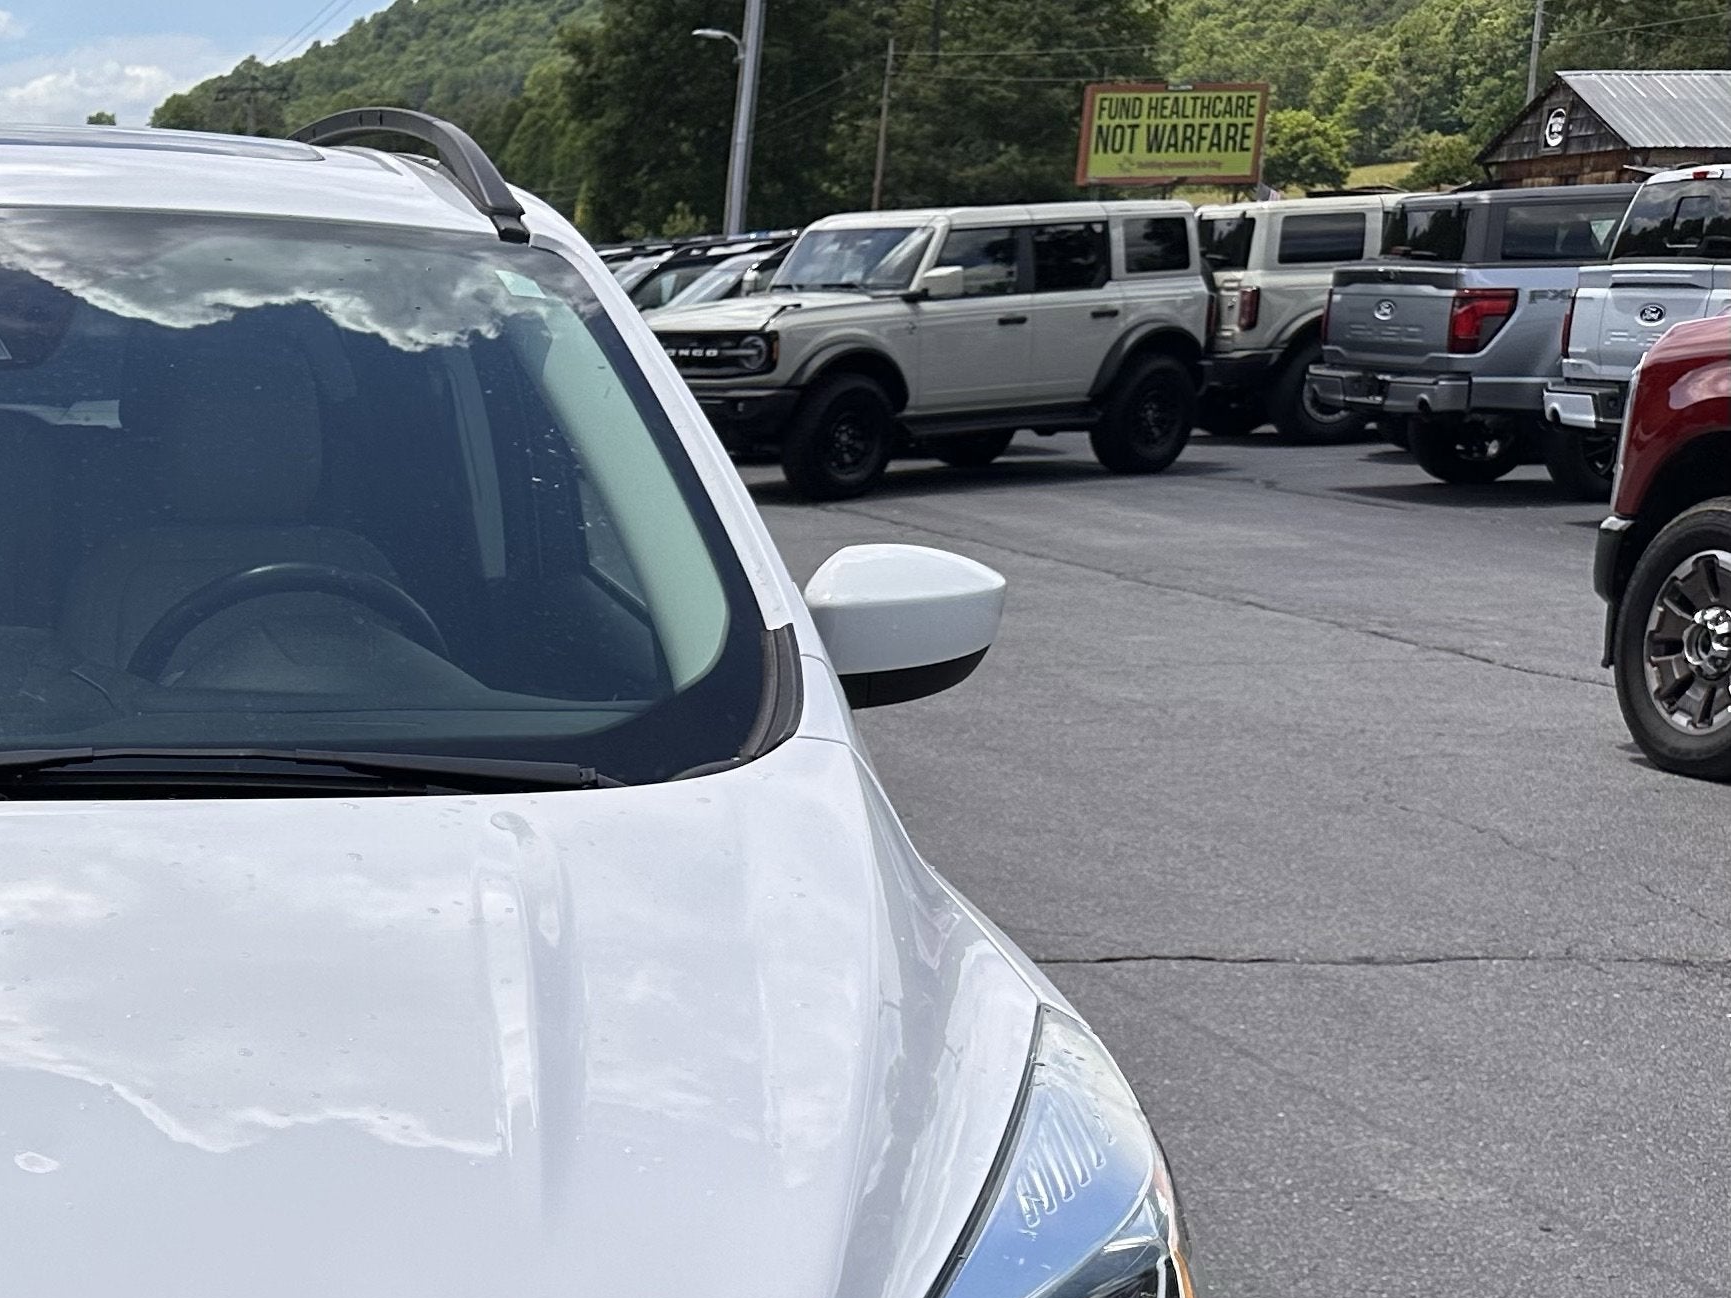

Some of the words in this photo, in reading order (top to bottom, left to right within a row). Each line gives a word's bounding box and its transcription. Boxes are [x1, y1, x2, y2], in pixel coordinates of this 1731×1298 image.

[1097, 97, 1143, 120] FUND
[1147, 95, 1257, 119] HEALTHCARE
[1094, 124, 1140, 154] NOT
[1146, 122, 1255, 153] WARFARE
